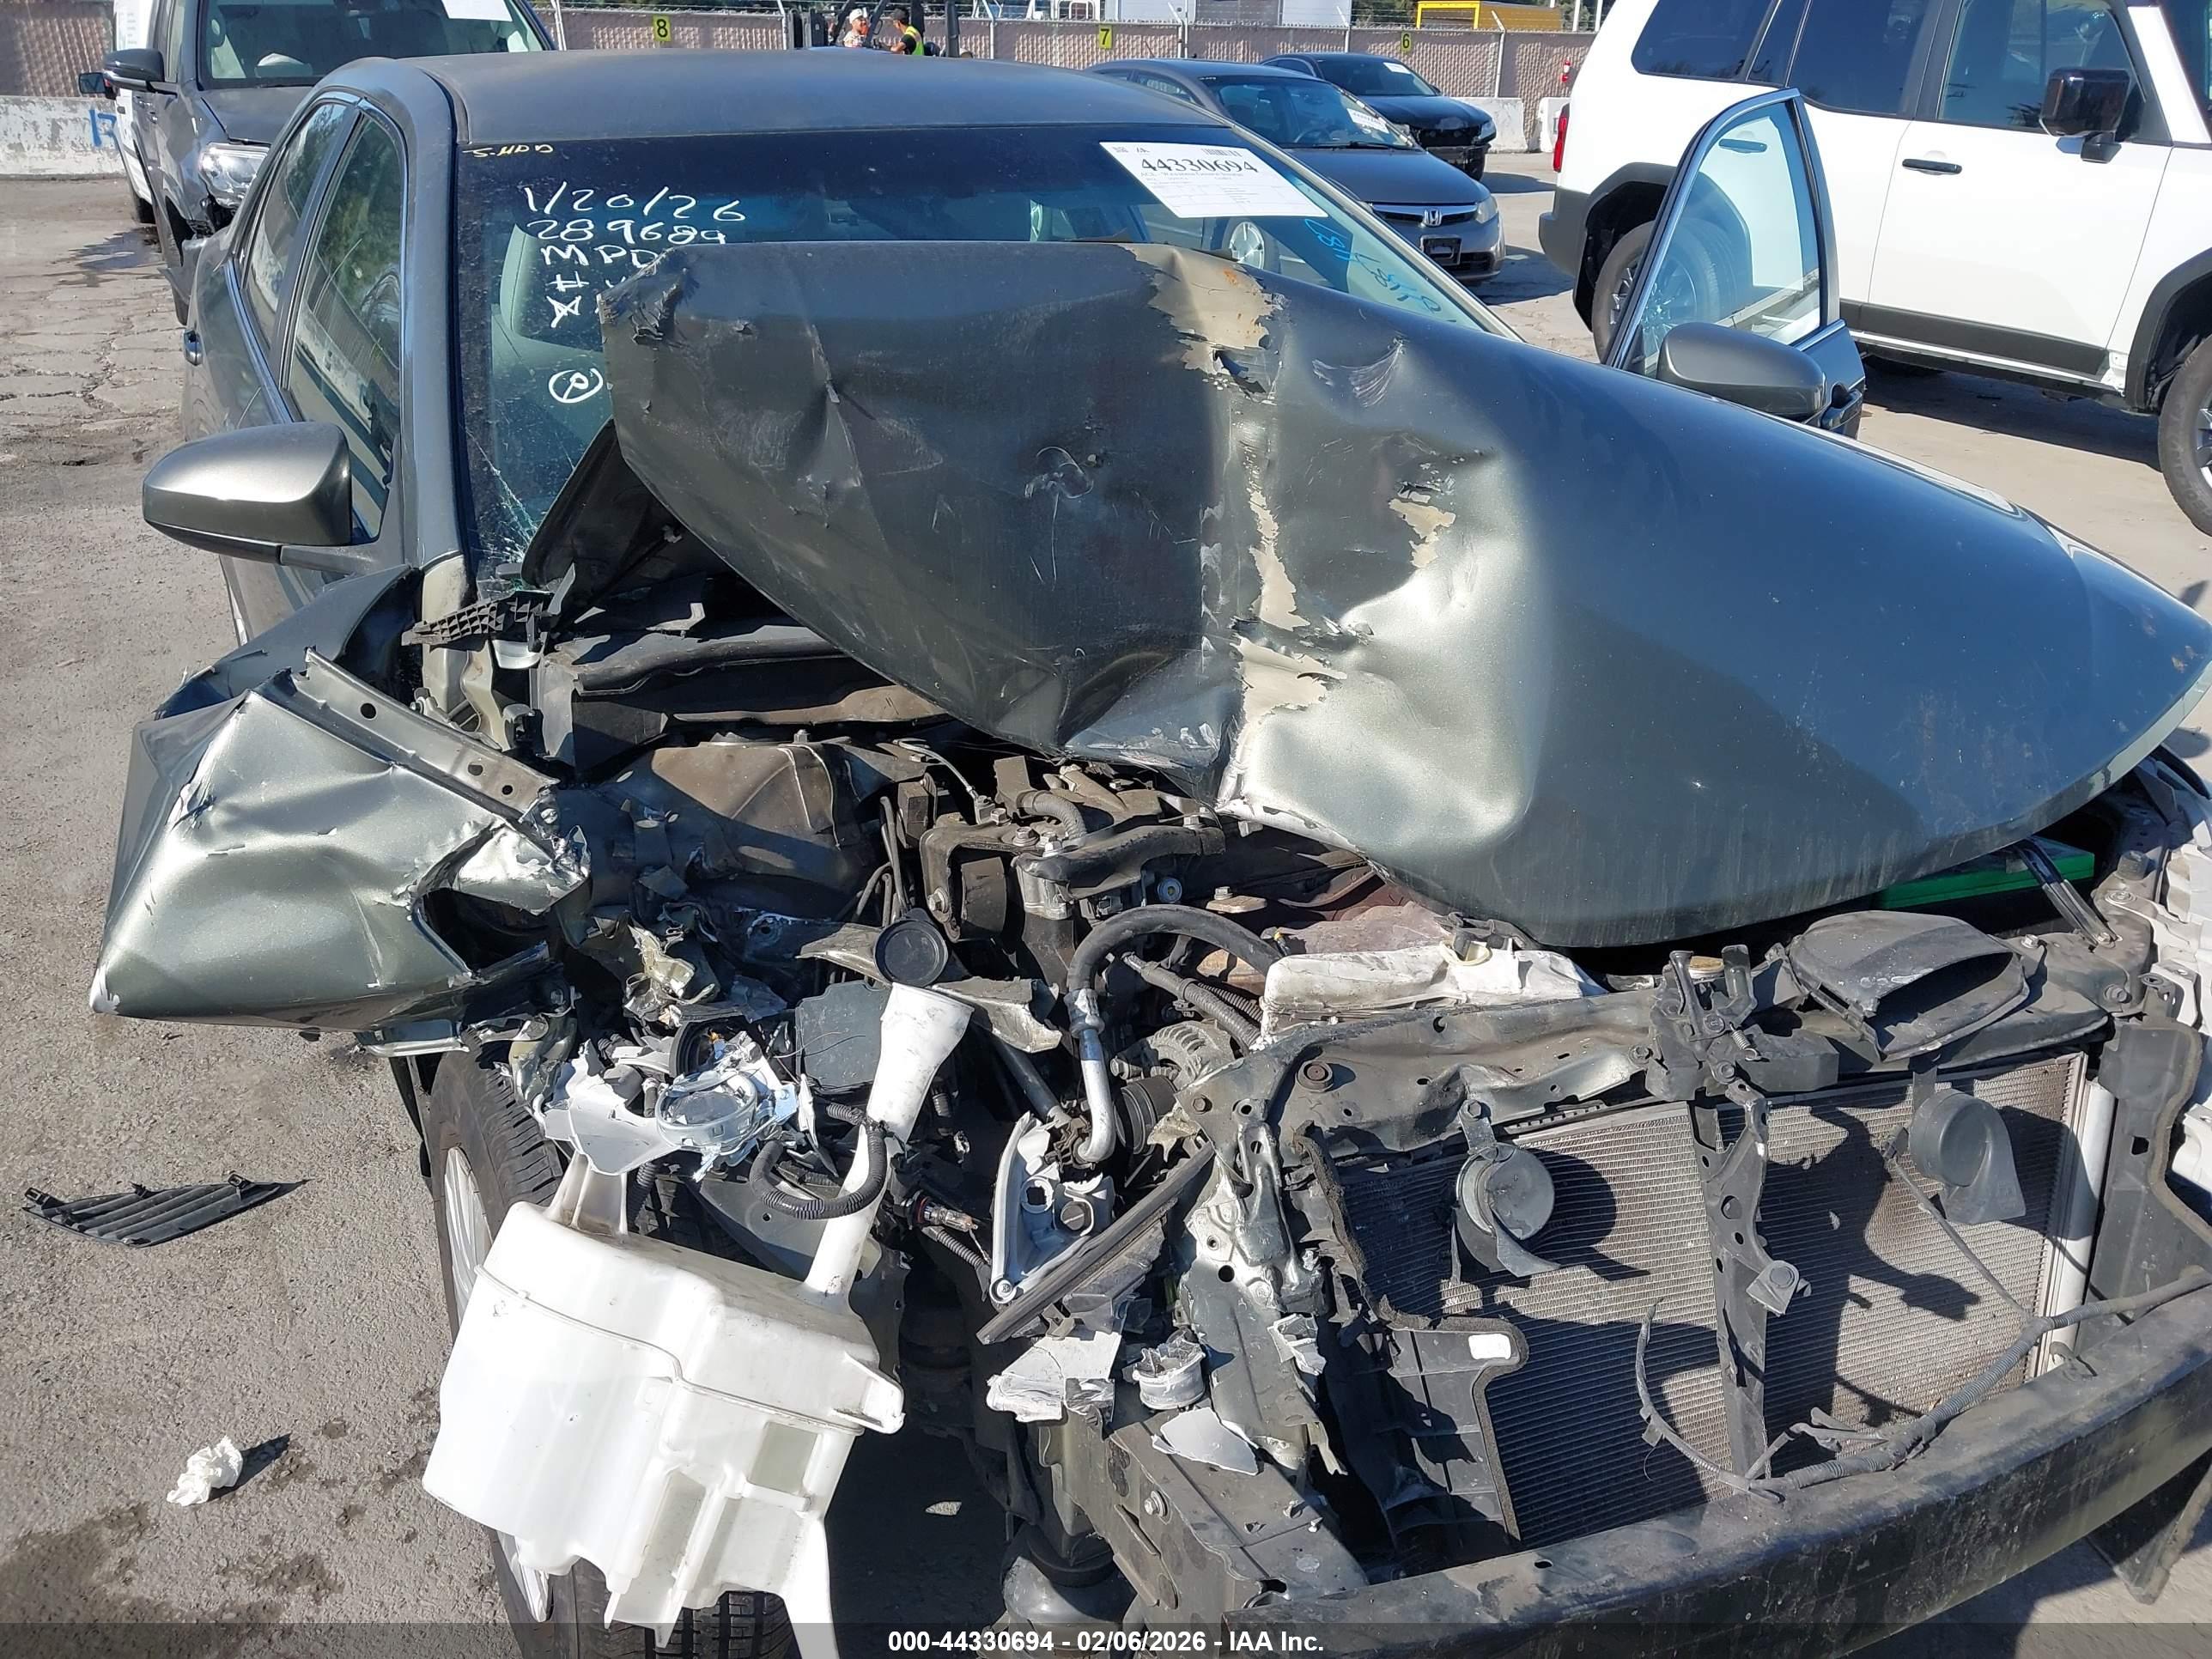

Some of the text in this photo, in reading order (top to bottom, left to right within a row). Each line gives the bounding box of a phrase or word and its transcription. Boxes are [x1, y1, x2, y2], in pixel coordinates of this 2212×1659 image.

[656, 18, 668, 38] 8
[1100, 28, 1110, 45] 7
[1402, 33, 1410, 49] 6
[1141, 158, 1259, 173] 44330694
[524, 181, 745, 222] 1/20/26
[526, 219, 726, 245] 289689
